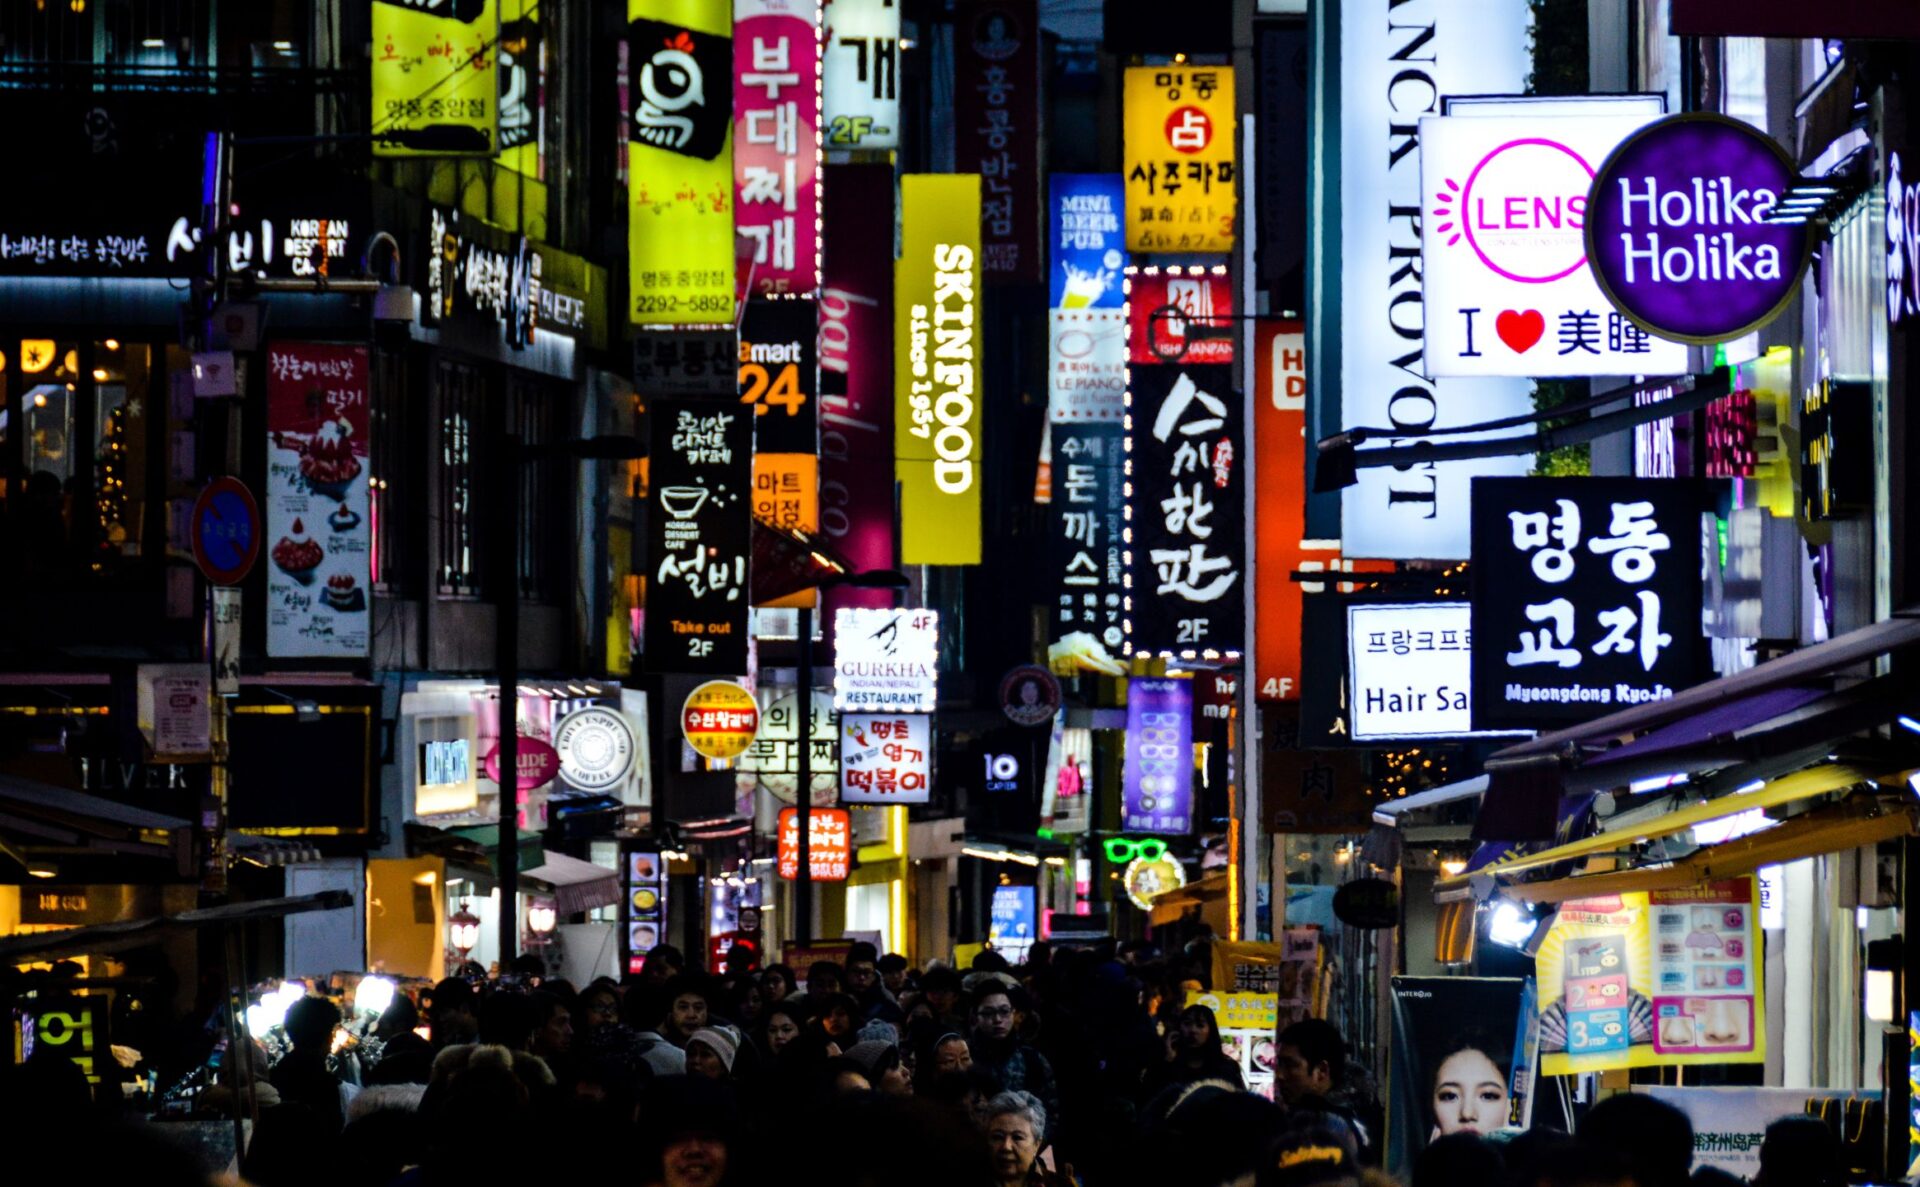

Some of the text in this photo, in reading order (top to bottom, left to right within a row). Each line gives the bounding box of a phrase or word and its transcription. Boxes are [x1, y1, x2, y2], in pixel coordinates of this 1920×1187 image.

[839, 37, 896, 100] 개
[1155, 72, 1218, 101] 명동
[1388, 0, 1437, 172] NCK
[831, 117, 873, 143] 2F
[1171, 110, 1206, 148] 占
[737, 36, 799, 271] 부대찌개
[976, 64, 1018, 237] 홍콩반점
[1061, 195, 1111, 212] MINI
[1477, 196, 1584, 230] LENS
[1619, 177, 1778, 227] Holika
[290, 219, 348, 238] KORAN
[1061, 213, 1118, 232] BEER
[166, 217, 274, 279] 빙
[284, 238, 346, 257] DESRT
[1061, 232, 1105, 249] PUB
[1621, 232, 1781, 283] Holika
[641, 271, 725, 287] 명동중앙점
[636, 294, 730, 313] 2292-5892
[739, 341, 801, 362] emart
[934, 244, 974, 494] SKINFOOD
[739, 363, 807, 417] 24
[1075, 377, 1123, 390] PIANO
[909, 380, 934, 439] 1957
[1061, 436, 1103, 459] 수제
[758, 471, 801, 496] 마트
[1063, 464, 1101, 586] 돈까스
[1507, 499, 1671, 583] 명동
[1107, 545, 1121, 585] cutlet
[670, 620, 731, 633] Take out
[912, 616, 931, 631] 4F
[1177, 619, 1209, 643] 2F
[1506, 590, 1673, 671] 교자
[688, 638, 713, 657] 2F
[842, 663, 928, 677] GURKHA
[846, 692, 923, 704] RESTAURANT
[1262, 677, 1293, 698] 4F
[1366, 687, 1468, 713] Hair Sa
[1506, 684, 1611, 702] Myeongdong
[495, 752, 548, 767] EUDE
[883, 743, 923, 763] 엽기
[846, 767, 926, 793] 떡볶이
[1572, 1021, 1588, 1048] 3
[1694, 1132, 1765, 1152] 济州岛芦
